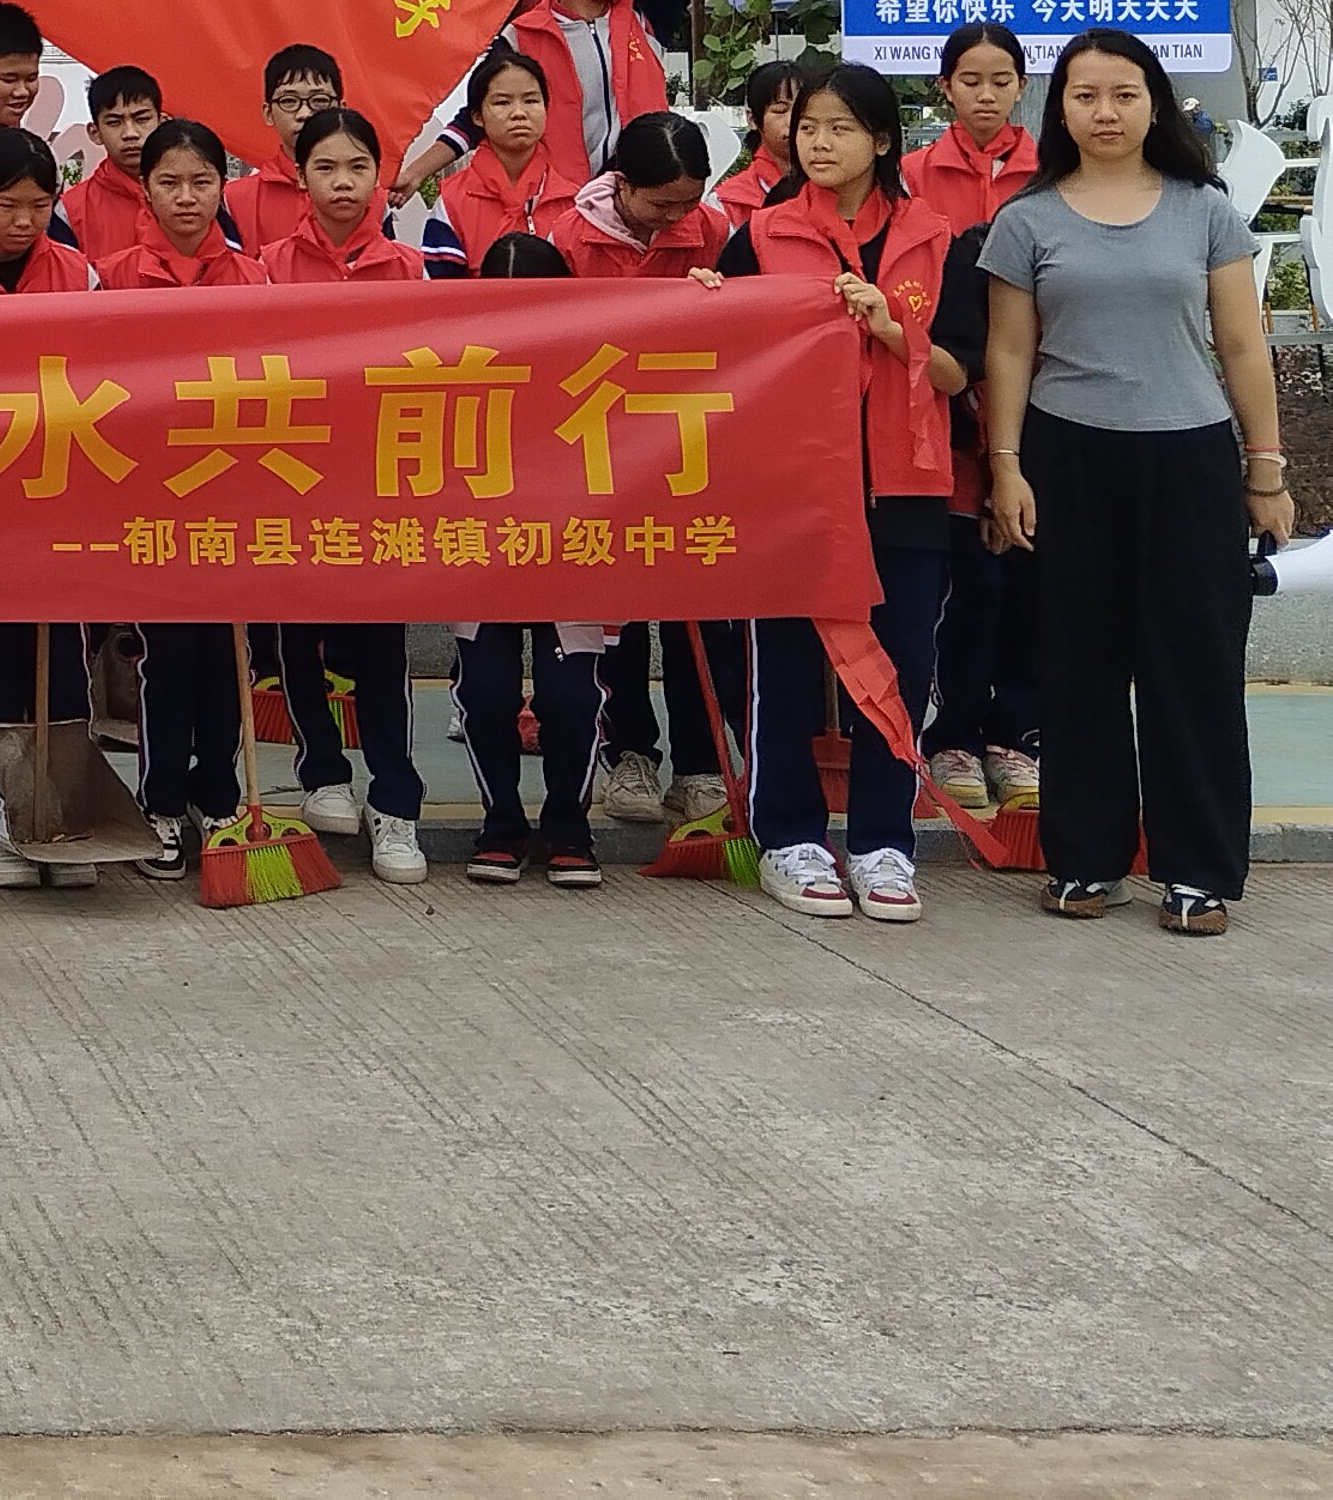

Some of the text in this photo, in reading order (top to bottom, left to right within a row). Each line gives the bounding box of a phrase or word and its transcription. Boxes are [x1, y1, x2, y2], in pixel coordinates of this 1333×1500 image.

[874, 46, 887, 60] XI
[889, 45, 931, 60] WANG
[1172, 44, 1202, 59] TIAN
